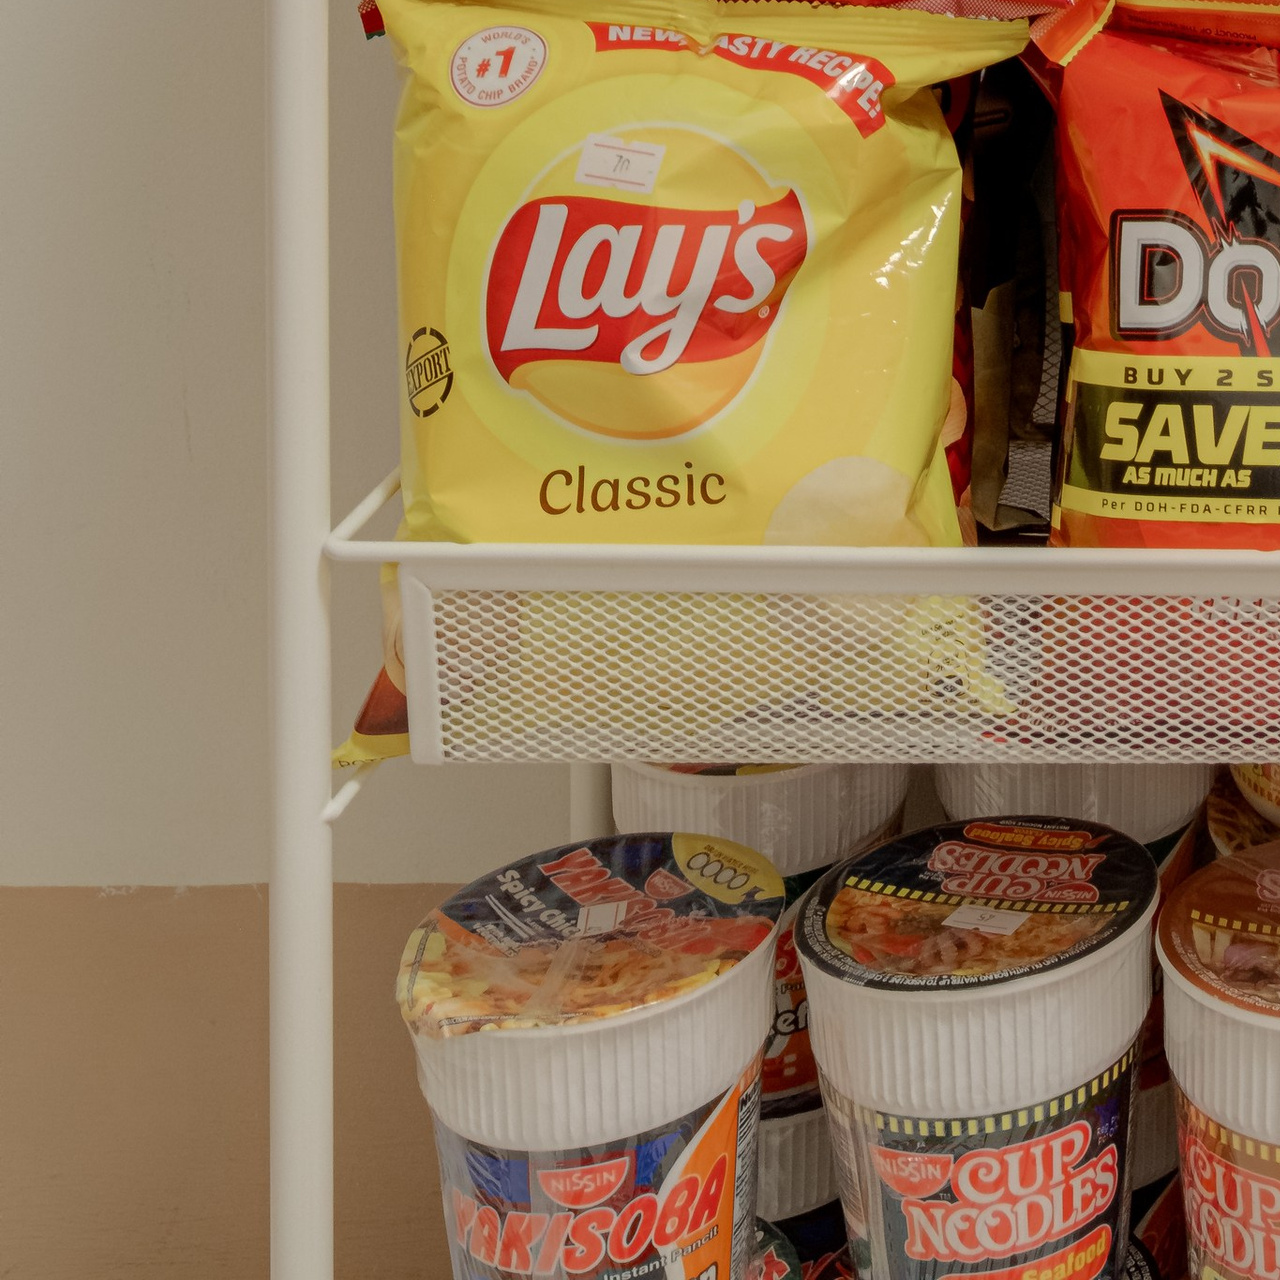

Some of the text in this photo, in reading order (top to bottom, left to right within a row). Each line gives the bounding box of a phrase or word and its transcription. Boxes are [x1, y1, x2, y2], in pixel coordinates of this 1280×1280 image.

[482, 32, 529, 44] WORLD'S
[458, 57, 475, 96] POTATO
[478, 88, 504, 101] CHIP
[608, 25, 688, 47] NEW,
[789, 43, 881, 117] RECIPE!
[501, 199, 794, 376] Lay's
[406, 345, 452, 393] EXPORT
[1124, 367, 1194, 387] BUY
[1216, 369, 1234, 387] 2
[539, 462, 726, 515] Classic
[1123, 468, 1251, 488] AS MUCH AS
[1102, 499, 1126, 511] Per
[1134, 501, 1270, 516] DOH-FDA-CFRR
[970, 829, 1083, 848] Spicy Seafood
[934, 844, 1099, 880] NOODLES
[498, 869, 546, 913] Spicy
[949, 875, 1041, 897] CUP
[1045, 891, 1093, 899] NISSIN
[551, 1172, 617, 1192] NISSIN
[876, 1156, 941, 1181] NISSIN
[957, 1126, 1086, 1201] CUP
[452, 1154, 728, 1274] YAKISOBA
[908, 1148, 1114, 1255] NOODLES
[603, 1225, 719, 1280] Instant Pancit
[1022, 1233, 1106, 1280] Seafood
